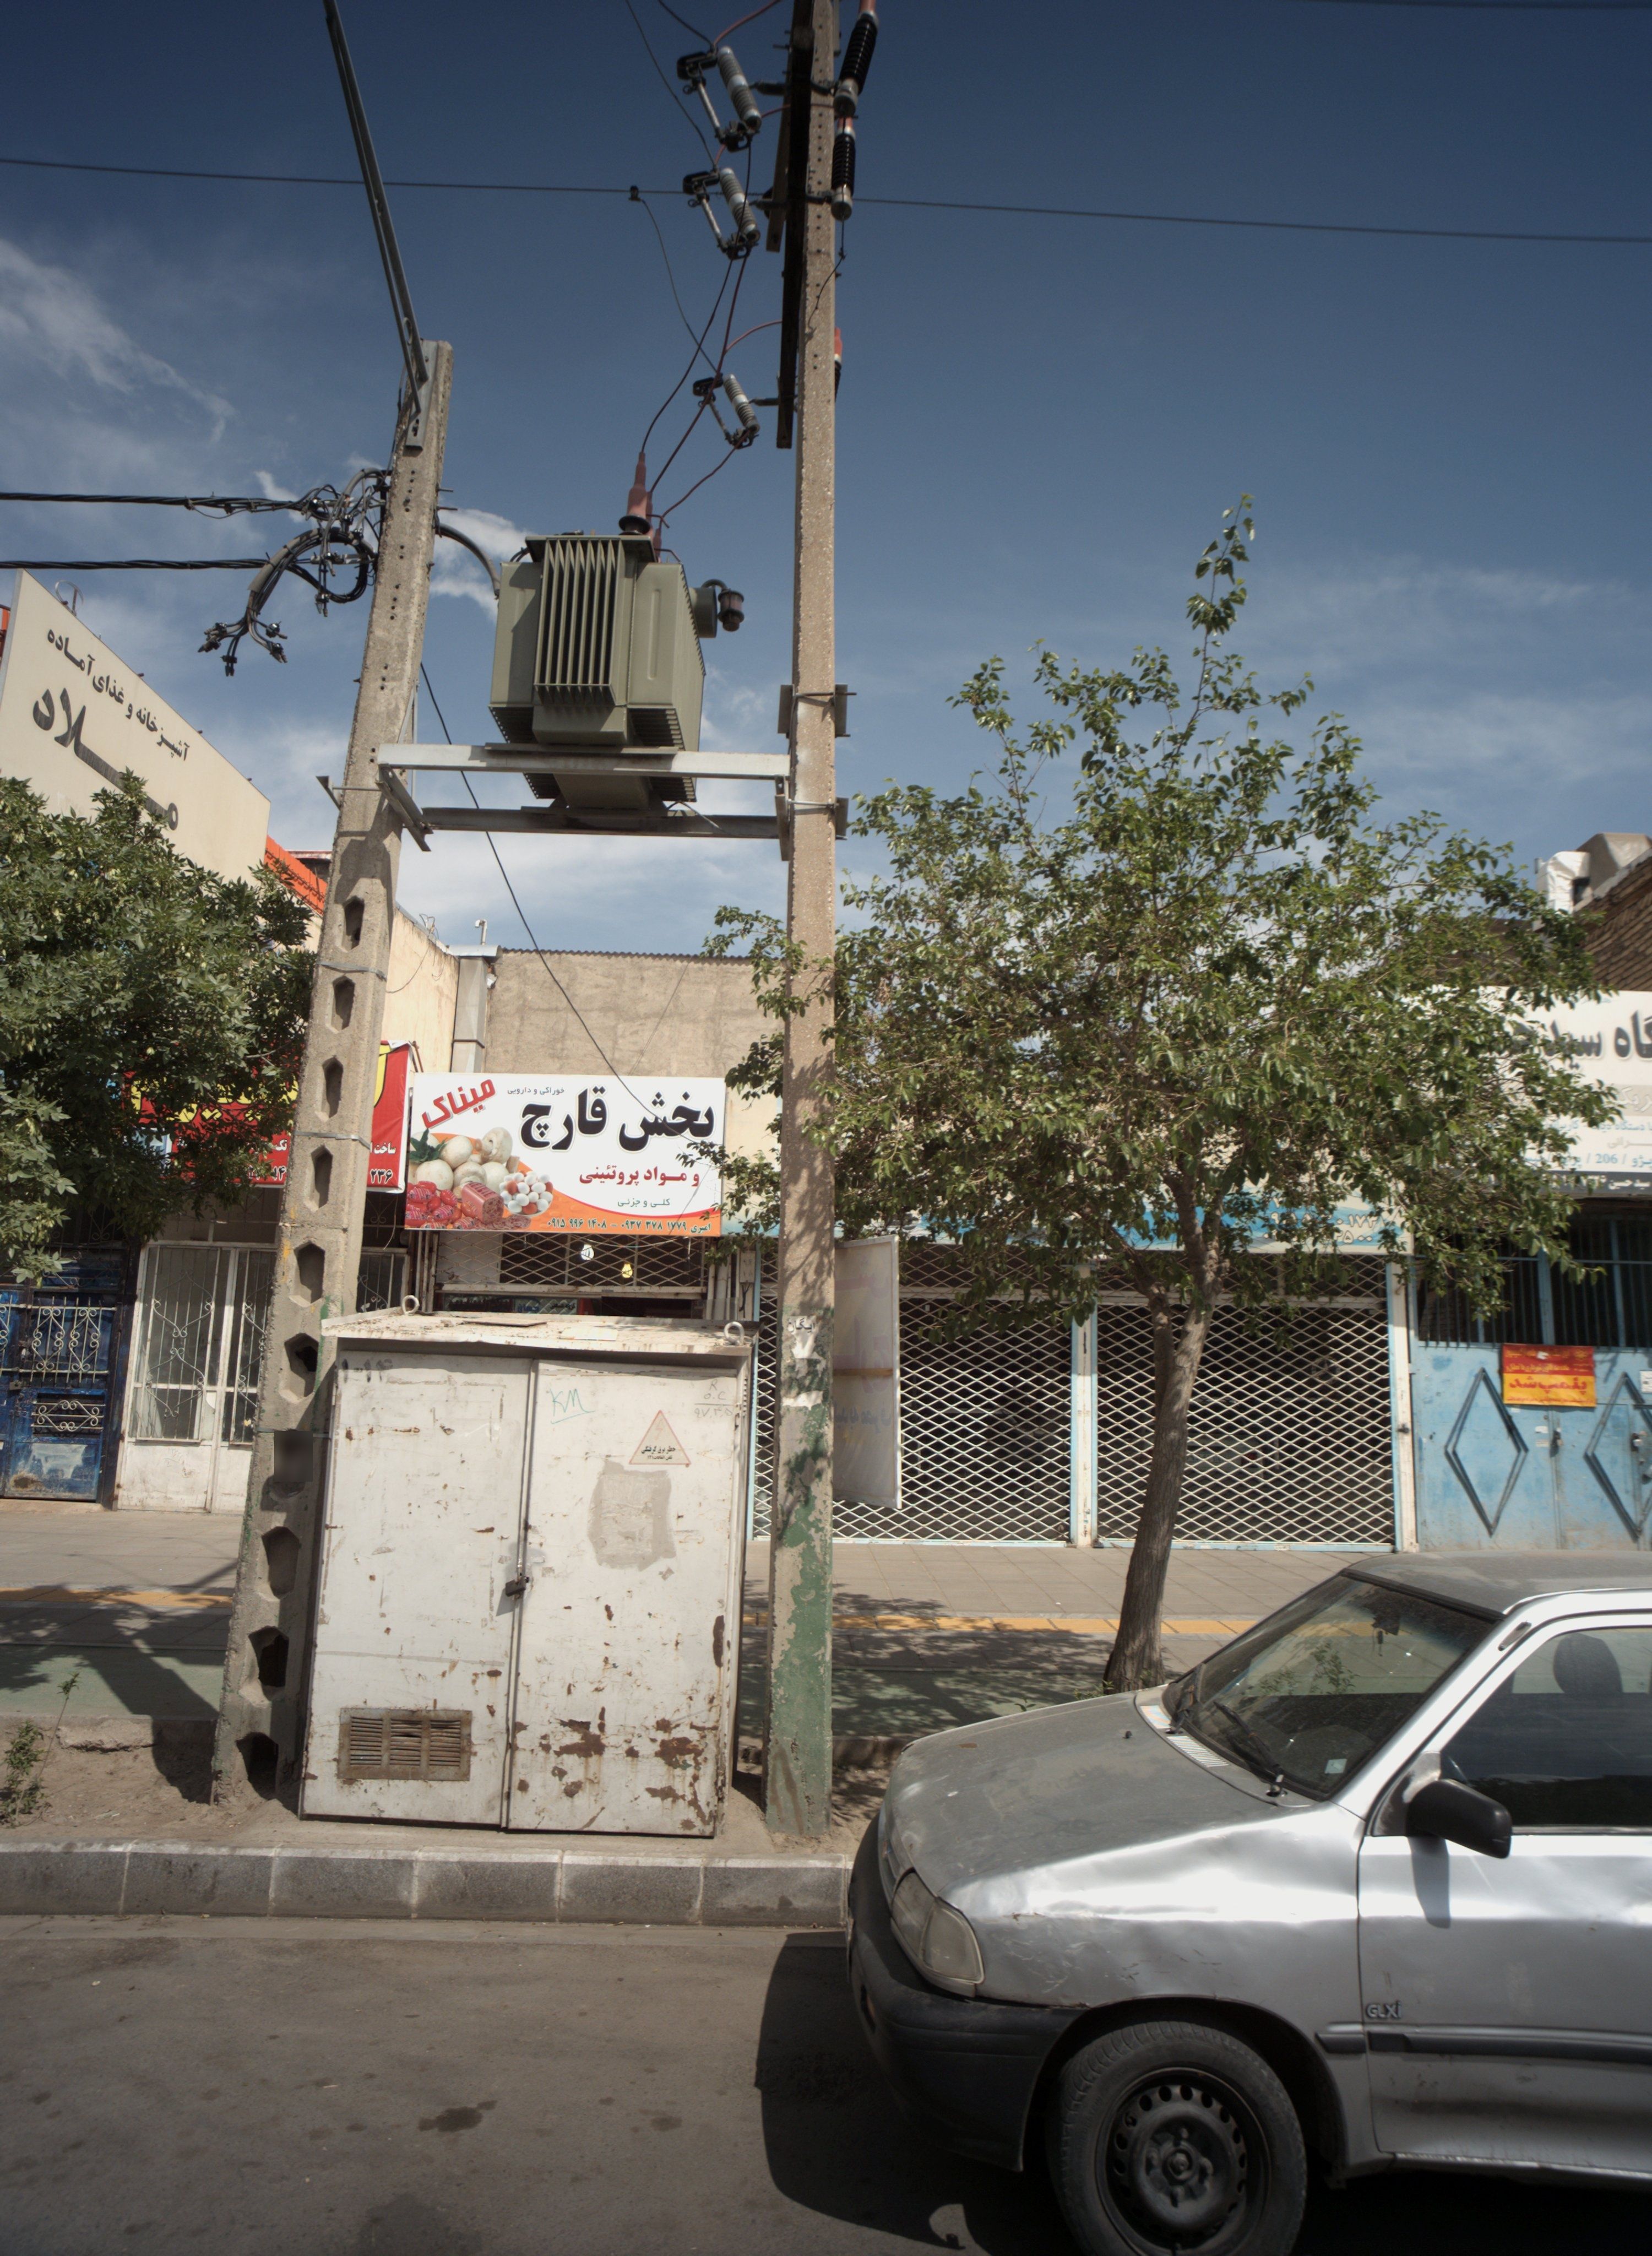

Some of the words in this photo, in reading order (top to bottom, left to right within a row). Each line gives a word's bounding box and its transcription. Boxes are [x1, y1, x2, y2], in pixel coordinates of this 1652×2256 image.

[47, 629, 95, 676] آماده
[92, 675, 124, 704] غذای
[125, 703, 133, 720] و
[32, 687, 178, 831] ملاد
[507, 1087, 531, 1095] دارویی
[539, 1087, 565, 1096] خوراکی
[421, 1078, 496, 1129] میناک
[520, 1086, 607, 1150] قارچ
[374, 1142, 396, 1154] ساخت
[1595, 1153, 1618, 1164] 206
[579, 1164, 639, 1186] پروتئینی
[643, 1166, 687, 1186] مواد
[691, 1173, 700, 1186] و
[650, 1198, 671, 1207] کلی
[547, 1218, 566, 1228] ۰۹۱۵
[569, 1218, 584, 1228] ۹۹۶
[588, 1219, 607, 1229] ۱۴۰۸
[621, 1219, 642, 1229] ۰۹۳۷
[645, 1221, 663, 1230] ۳۷۸
[667, 1221, 687, 1231] ۱۷۷۹
